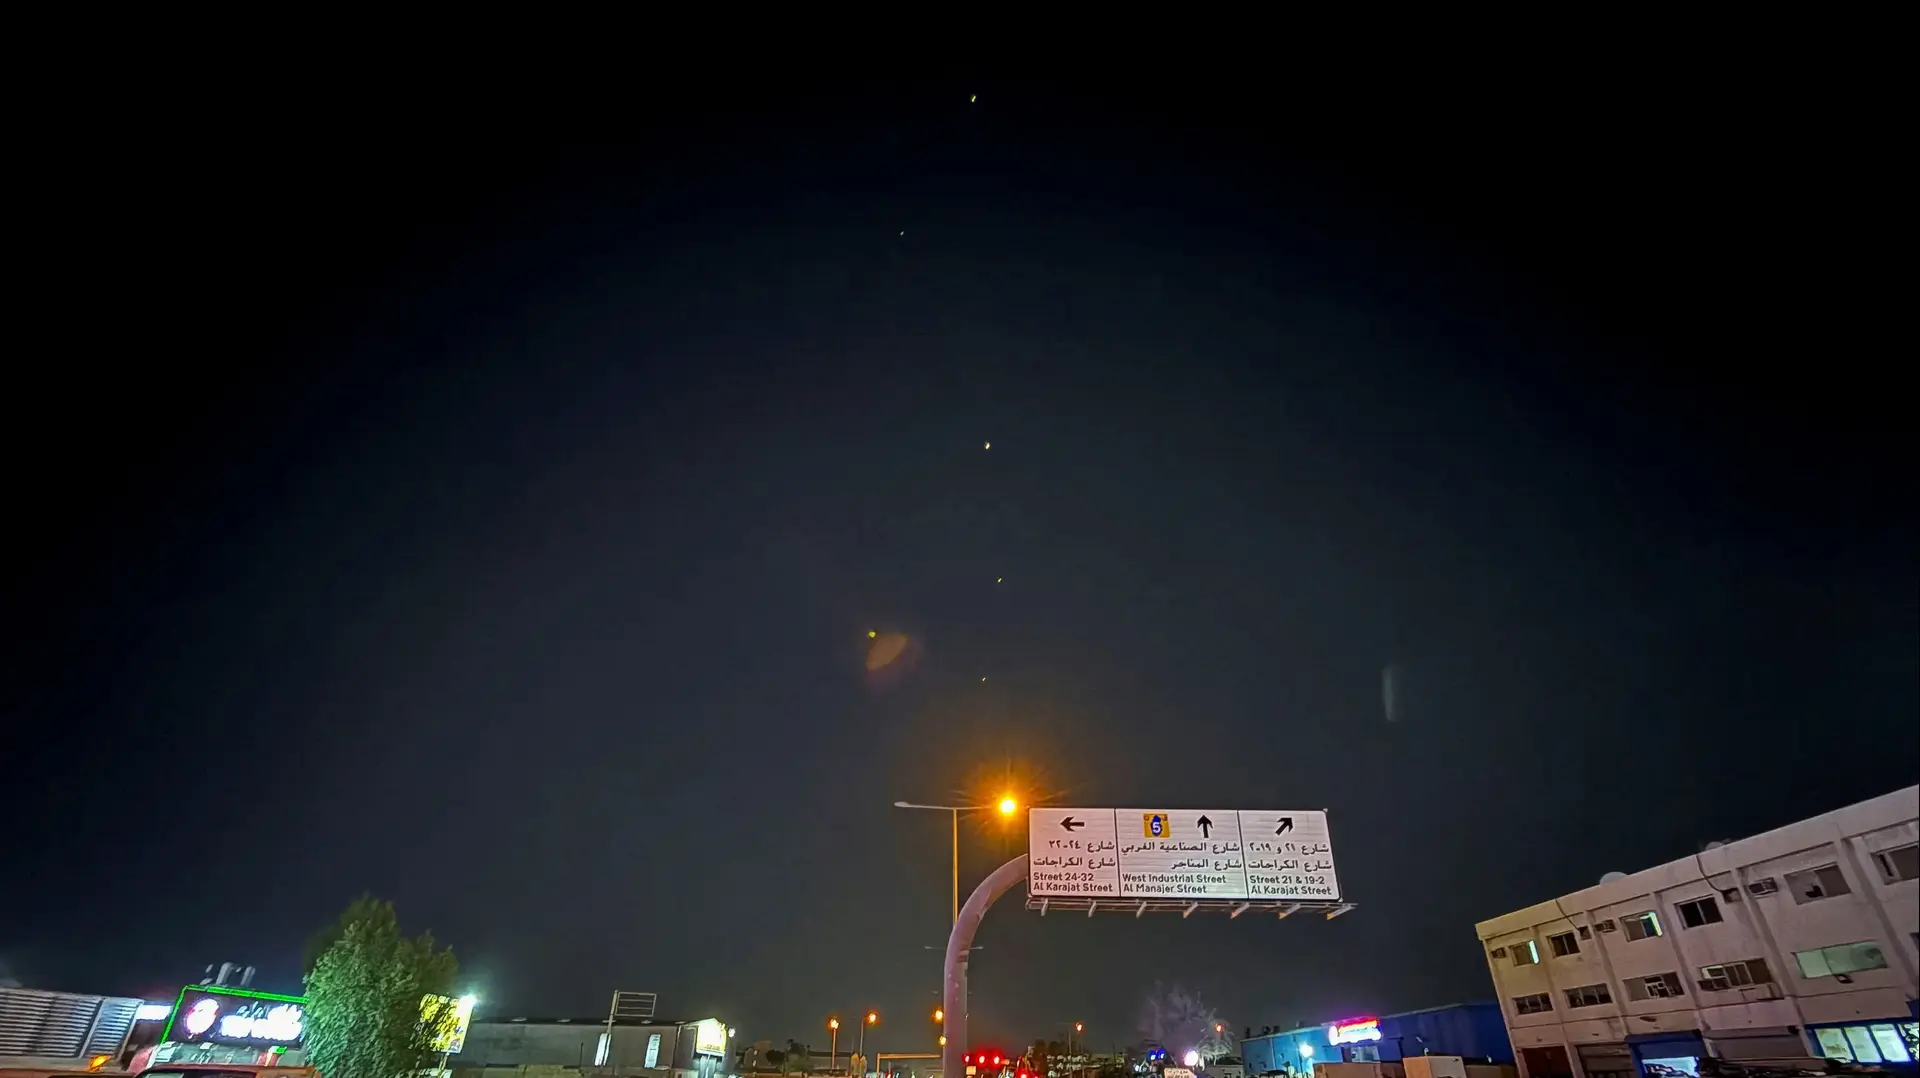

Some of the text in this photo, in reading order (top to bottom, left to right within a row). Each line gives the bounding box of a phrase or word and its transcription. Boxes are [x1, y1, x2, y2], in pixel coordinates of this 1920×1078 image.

[1152, 822, 1161, 833] 5
[1087, 841, 1115, 852] شارع
[1121, 842, 1240, 856] شارع الصناعية الغربي
[1276, 846, 1282, 854] و
[1301, 843, 1329, 855] شارع
[1033, 857, 1116, 869] شارع الكراجات
[1214, 860, 1242, 871] شارع
[1248, 860, 1332, 872] شارع الكراجات
[1033, 873, 1094, 881] Street 24-32
[1122, 874, 1226, 883] West Industrial Street
[1249, 876, 1325, 884] Street 21 & 19-2
[1033, 882, 1113, 893] Al Karajat Street
[1123, 884, 1207, 894] Al Manajer Street
[1251, 886, 1332, 896] Al Karajat Street
